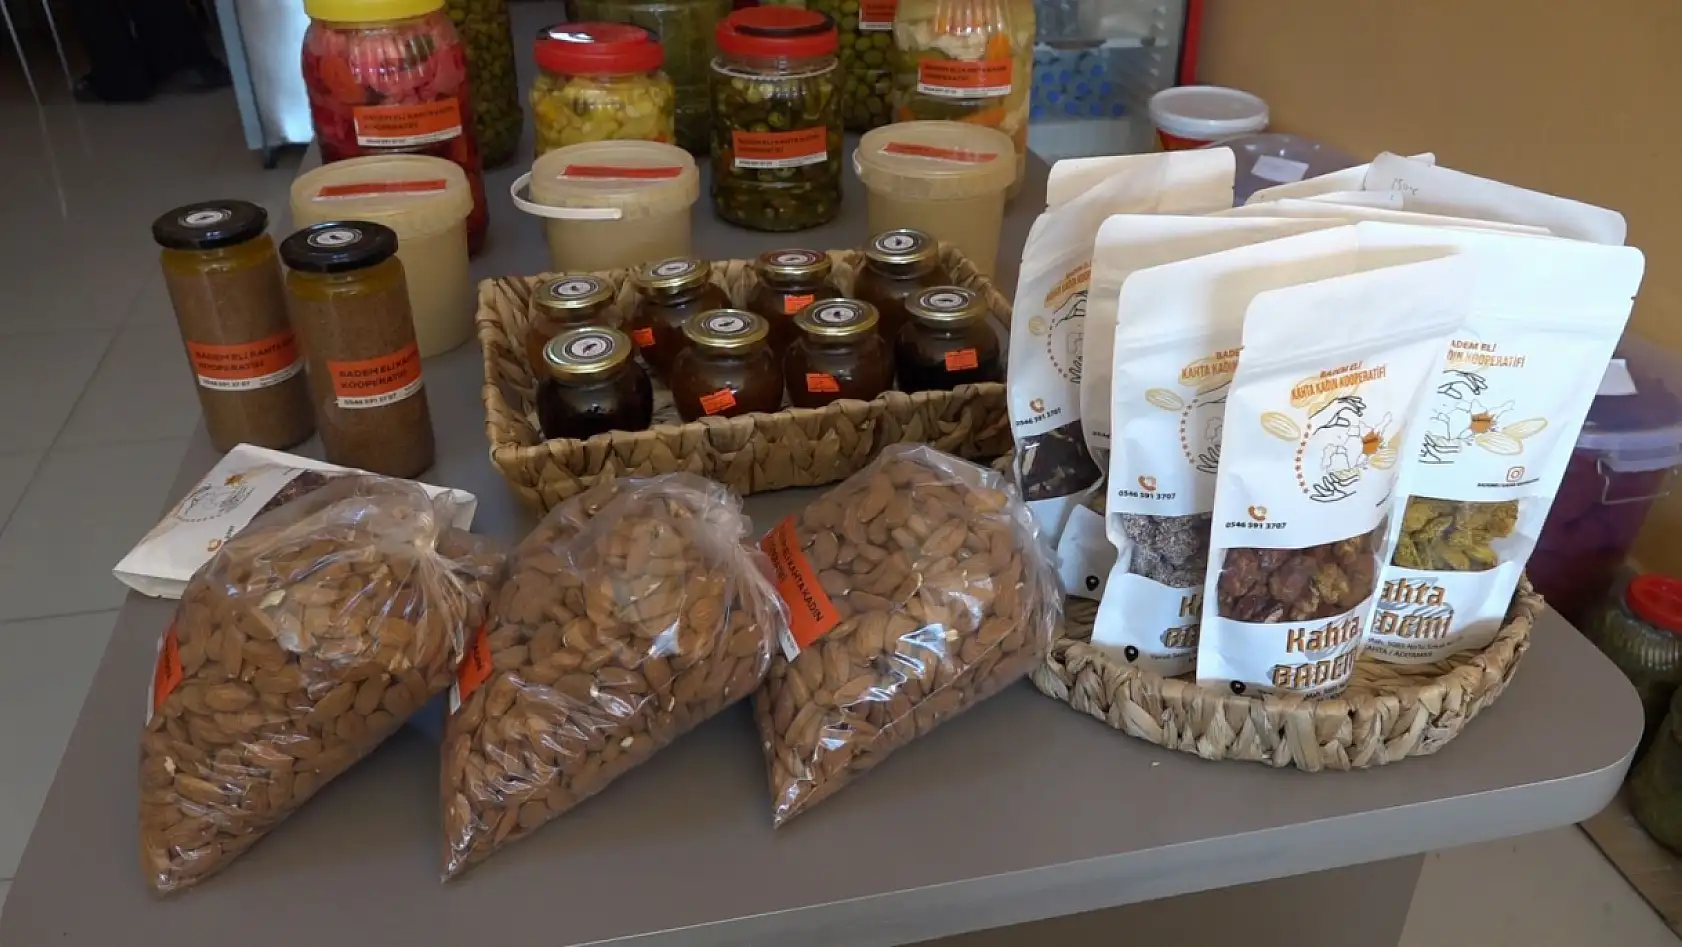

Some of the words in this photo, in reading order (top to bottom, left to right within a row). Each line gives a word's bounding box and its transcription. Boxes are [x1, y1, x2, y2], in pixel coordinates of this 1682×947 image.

[1216, 349, 1239, 360] BADE
[1340, 363, 1387, 388] KOOPERATİFİ
[1118, 489, 1139, 498] 0546
[1156, 492, 1176, 501] 3707
[1265, 522, 1287, 530] 3707
[1381, 577, 1445, 607] ahta
[801, 588, 824, 622] KADIN
[1285, 615, 1360, 654] Kahta
